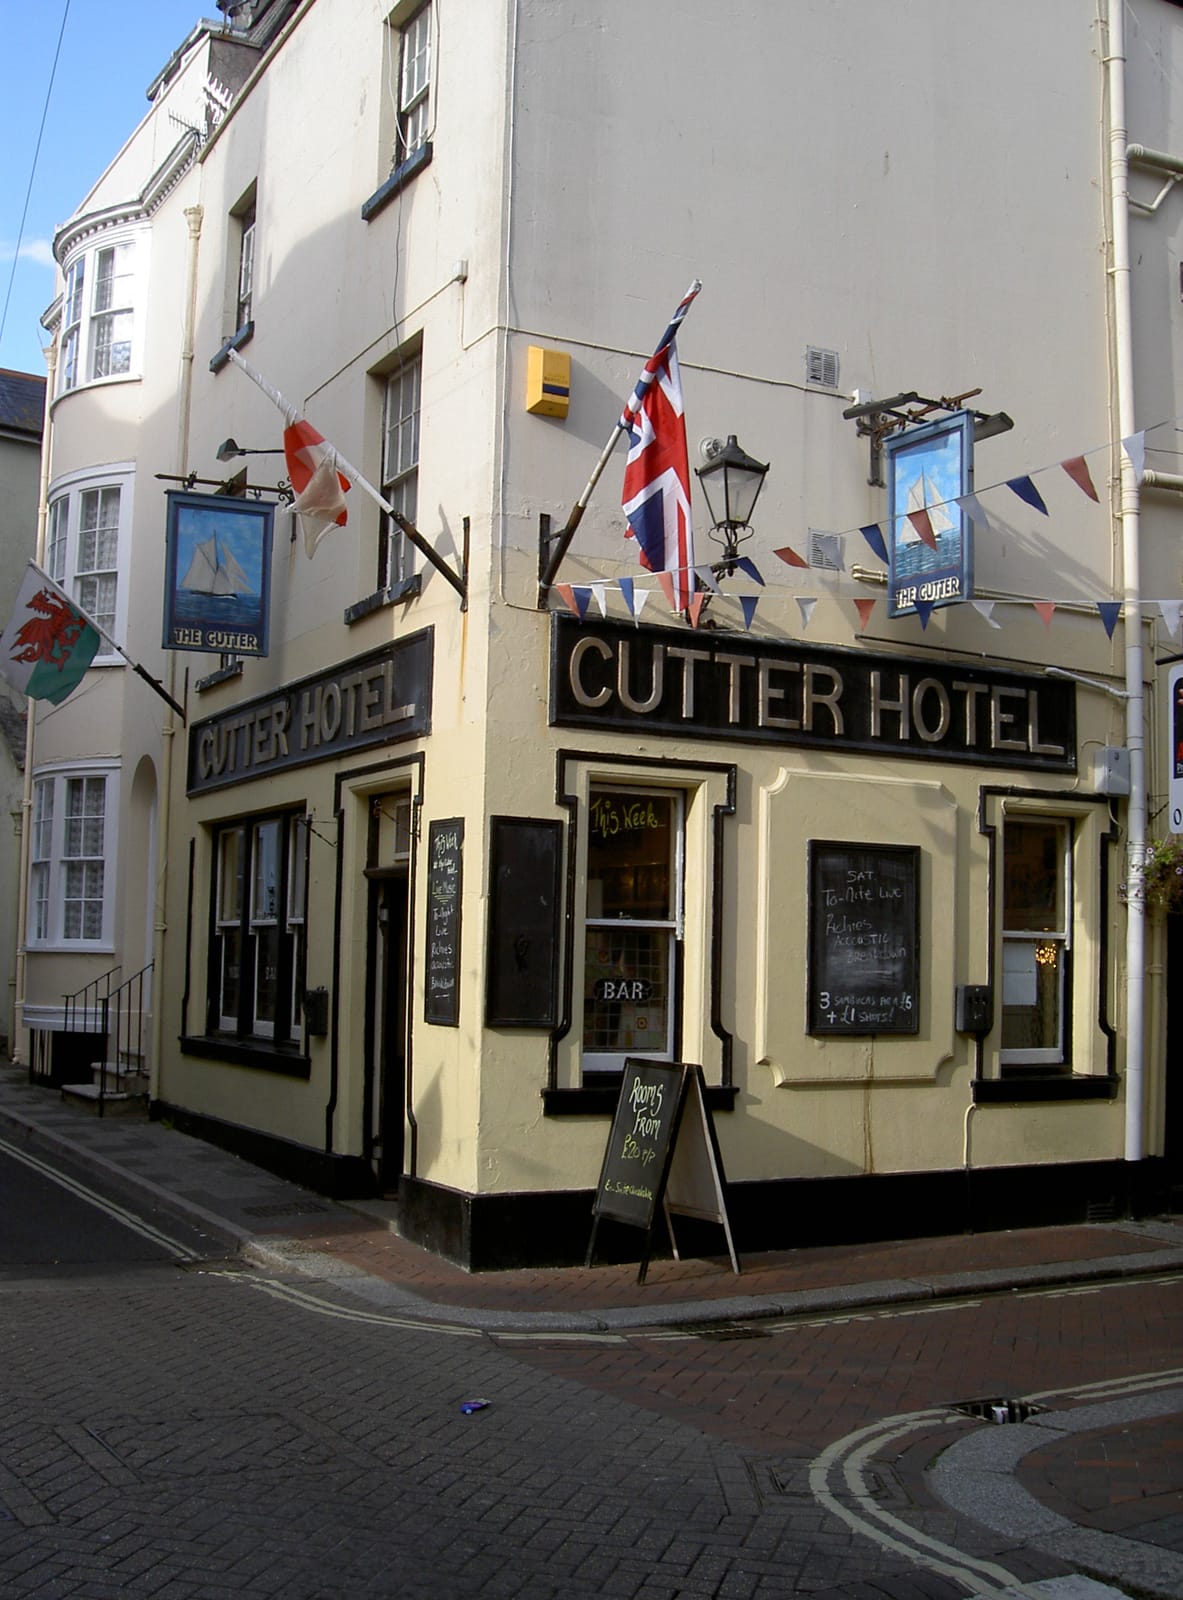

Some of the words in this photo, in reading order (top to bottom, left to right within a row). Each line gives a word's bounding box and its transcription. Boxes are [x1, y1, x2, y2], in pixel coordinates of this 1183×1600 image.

[896, 586, 917, 608] THE
[919, 576, 960, 601] CUTTER
[174, 627, 202, 646] THE
[206, 630, 258, 650] CUTTER
[570, 635, 845, 736] CUTTER
[869, 670, 1065, 756] HOTEL
[200, 699, 292, 780] CUTTER
[301, 660, 416, 750] HOTEL
[590, 798, 619, 838] This
[603, 981, 644, 999] BAR
[820, 991, 831, 1010] 3
[621, 1133, 641, 1159] £20
